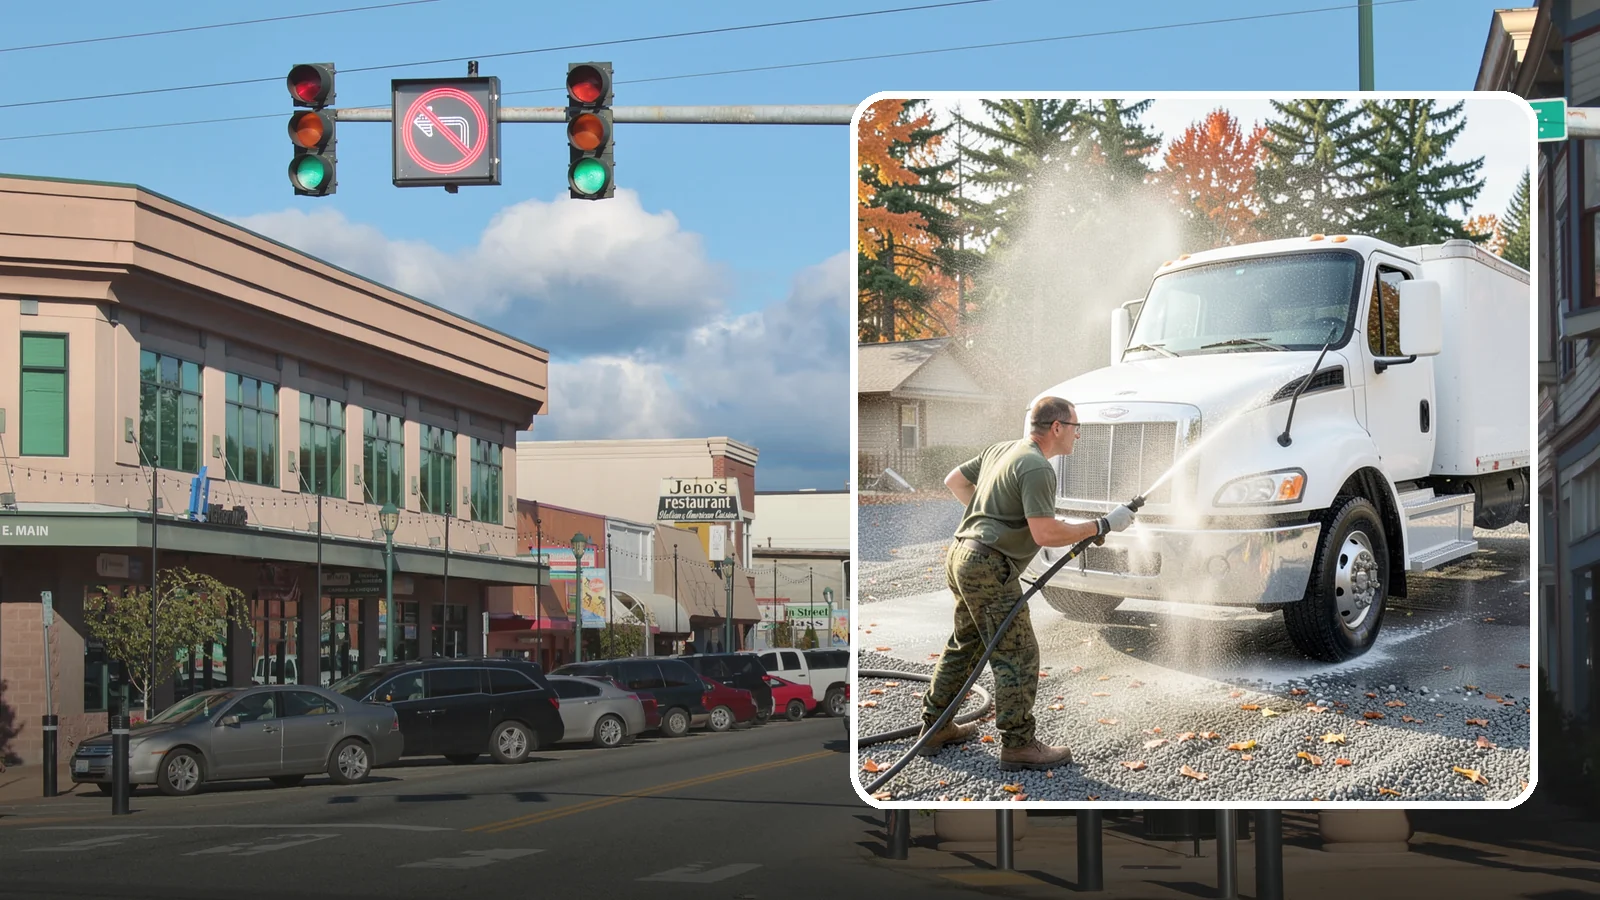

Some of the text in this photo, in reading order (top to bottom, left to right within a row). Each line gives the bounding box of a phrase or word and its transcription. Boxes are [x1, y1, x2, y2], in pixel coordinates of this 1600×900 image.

[669, 480, 727, 494] Jeno's
[665, 496, 731, 509] restaurant
[658, 509, 681, 519] Italian
[686, 509, 714, 519] American
[715, 509, 737, 519] Cuisine
[2, 525, 49, 536] E. MAIN
[791, 619, 824, 627] lass
